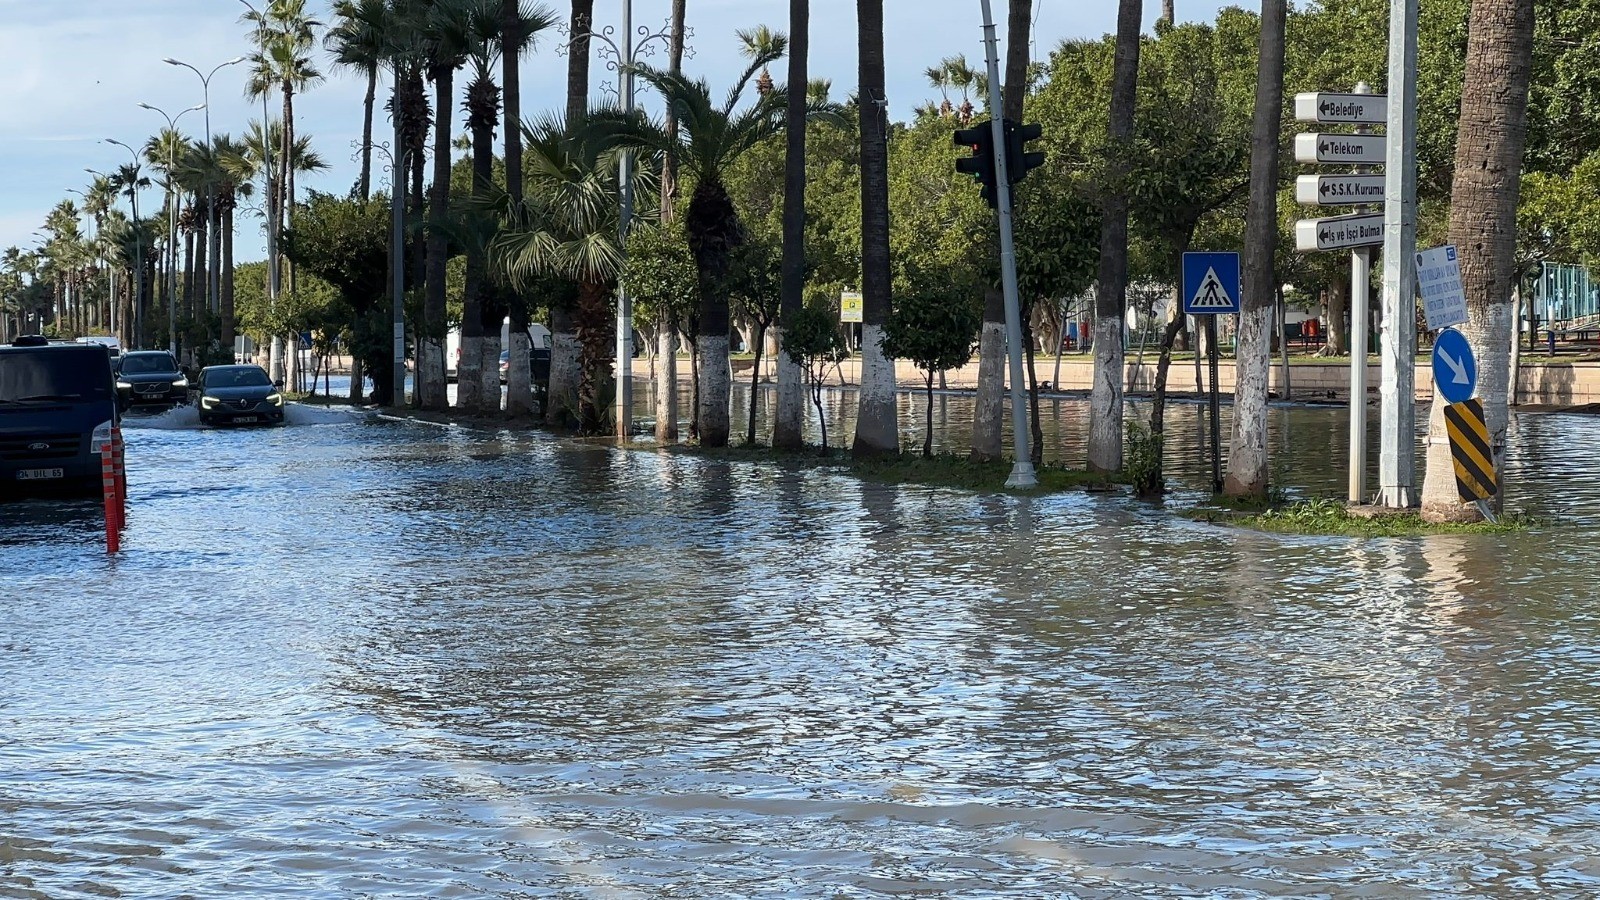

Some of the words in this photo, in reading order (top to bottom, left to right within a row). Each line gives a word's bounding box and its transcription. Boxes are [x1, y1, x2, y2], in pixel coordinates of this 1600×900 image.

[1330, 102, 1363, 119] Belediye
[1330, 142, 1363, 155] Telekom
[1355, 183, 1384, 195] Kurumu
[1337, 230, 1344, 241] ve
[1360, 224, 1380, 238] Bulma
